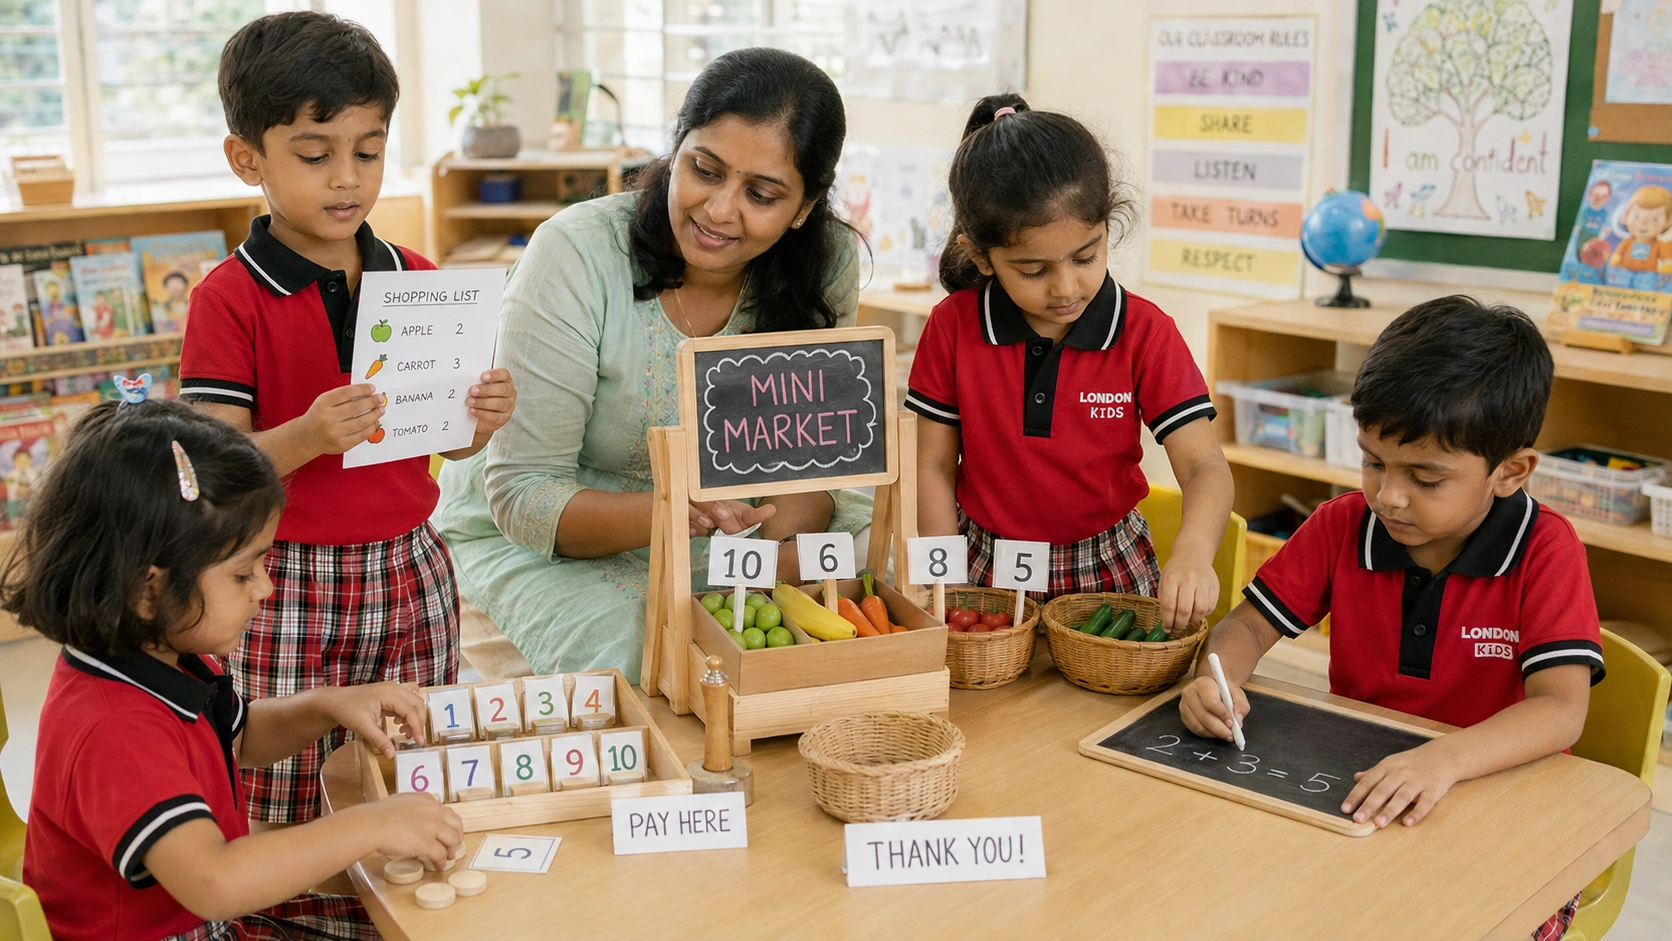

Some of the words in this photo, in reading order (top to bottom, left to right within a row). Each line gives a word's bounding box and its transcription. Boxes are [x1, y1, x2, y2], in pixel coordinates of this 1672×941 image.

[1269, 29, 1310, 48] RULES
[1189, 68, 1210, 89] BE
[1222, 68, 1264, 88] KIND
[1199, 114, 1252, 134] SHARE
[1194, 160, 1257, 180] LISTEN
[1406, 152, 1439, 170] am
[1170, 202, 1212, 224] TAKE
[1226, 206, 1279, 229] TURNS
[1181, 248, 1255, 272] RESPECT
[384, 290, 448, 304] SHOPPING
[454, 290, 480, 302] LIST
[400, 325, 434, 336] APPLE
[456, 323, 464, 334] 2
[397, 360, 436, 372] CARROT
[453, 358, 460, 369] 3
[396, 392, 434, 404] BANANA
[448, 389, 456, 399] 2
[751, 369, 824, 406] MINI
[1080, 392, 1132, 404] LONDON
[1090, 406, 1124, 418] KIDS
[392, 424, 428, 437] TOMATO
[442, 421, 449, 431] 2
[724, 410, 858, 452] MARKET
[722, 548, 762, 580] 10
[819, 543, 838, 573] 6
[928, 547, 948, 578] 8
[1014, 552, 1032, 582] 5
[1461, 626, 1519, 642] LONDON
[489, 697, 508, 722] 2
[538, 691, 554, 716] 3
[584, 689, 602, 714] 4
[444, 703, 460, 728] 1
[516, 754, 534, 780] 8
[566, 749, 584, 776] 9
[608, 744, 637, 772] 10
[1146, 735, 1180, 756] 2
[1193, 751, 1218, 761] +
[1226, 754, 1260, 774] 3
[1267, 768, 1288, 778] =
[1300, 772, 1340, 792] 5
[410, 765, 429, 792] 6
[461, 758, 479, 786] 7
[629, 811, 668, 838] PAY
[678, 808, 730, 835] HERE
[494, 846, 532, 860] 5
[867, 837, 959, 870] THANK
[967, 834, 1025, 866] YOU!
